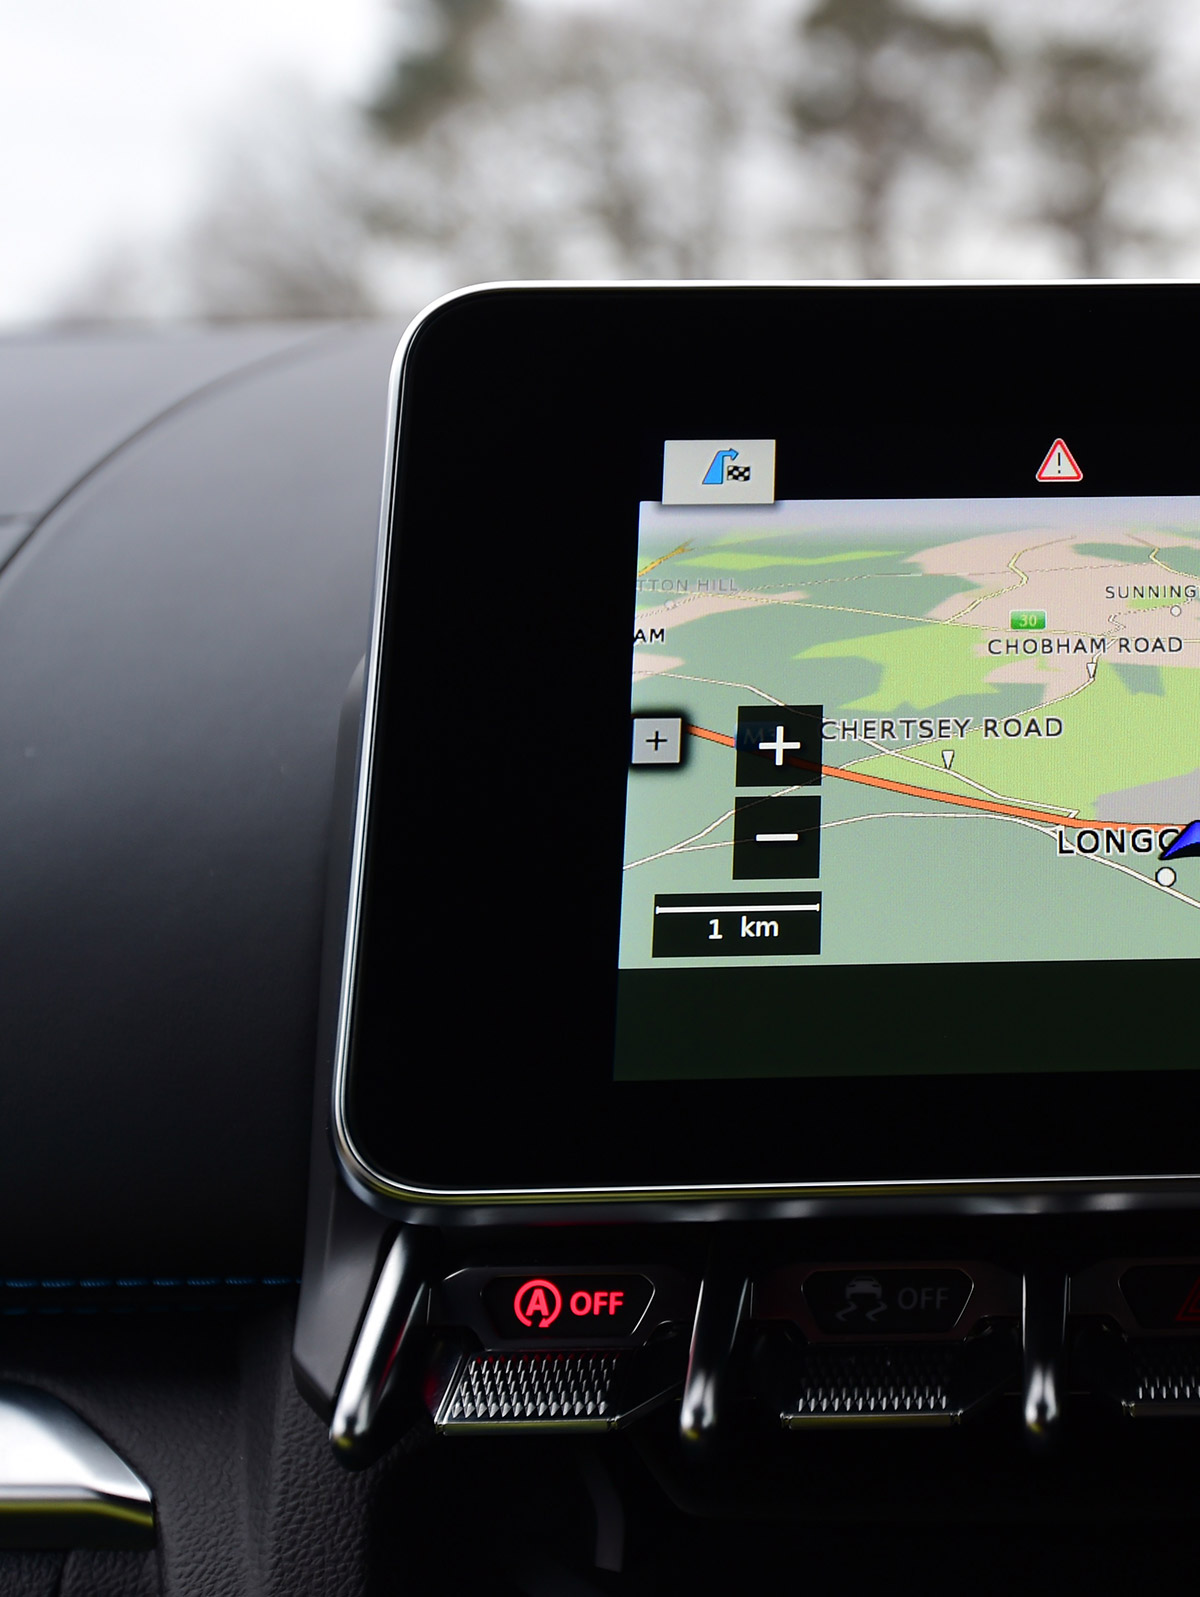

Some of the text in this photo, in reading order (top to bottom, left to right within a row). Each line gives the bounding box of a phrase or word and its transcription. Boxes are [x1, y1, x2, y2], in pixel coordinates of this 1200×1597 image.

[696, 578, 738, 592] HILL
[1018, 615, 1038, 627] 30
[634, 628, 665, 643] AM
[987, 637, 1184, 655] CHOBHAM ROAD
[820, 718, 1064, 741] CHERTSEY ROAD
[709, 915, 779, 939] 1 km
[569, 1291, 624, 1316] OFF
[898, 1287, 950, 1312] OFF
